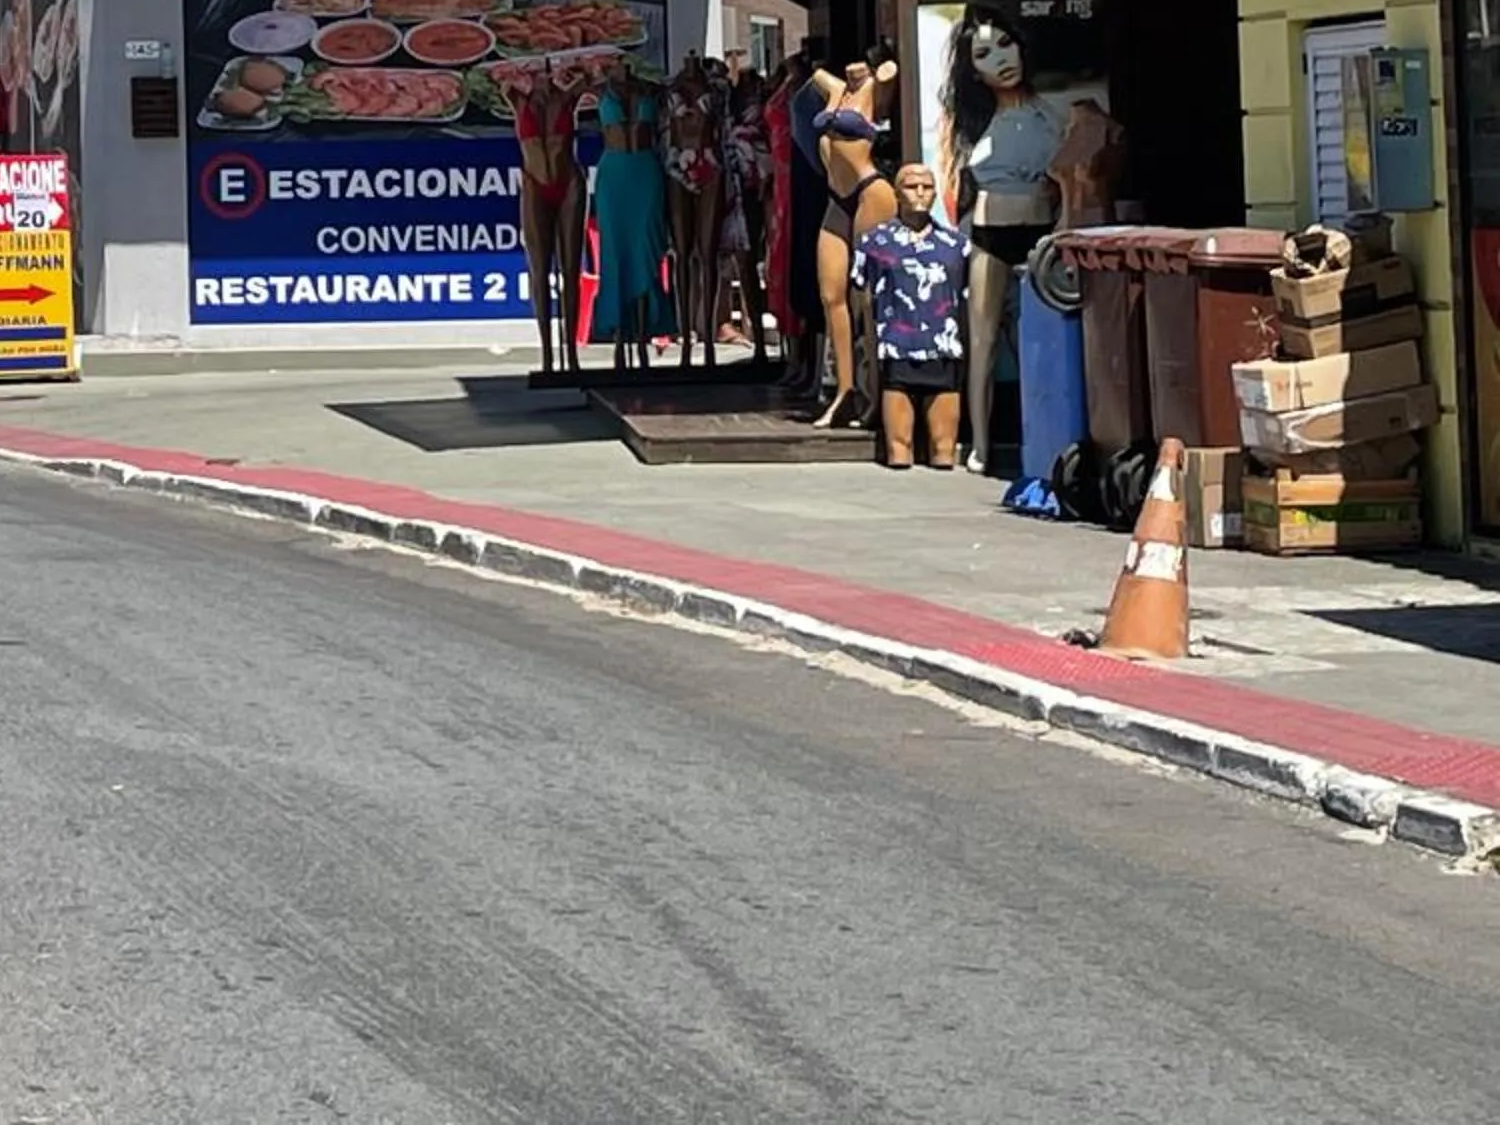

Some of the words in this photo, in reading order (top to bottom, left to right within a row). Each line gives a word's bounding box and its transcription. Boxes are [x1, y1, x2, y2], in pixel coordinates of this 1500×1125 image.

[17, 211, 45, 228] 20
[317, 223, 526, 255] CONVENIAD
[195, 274, 473, 305] RESTAURANTE
[484, 272, 507, 301] 2
